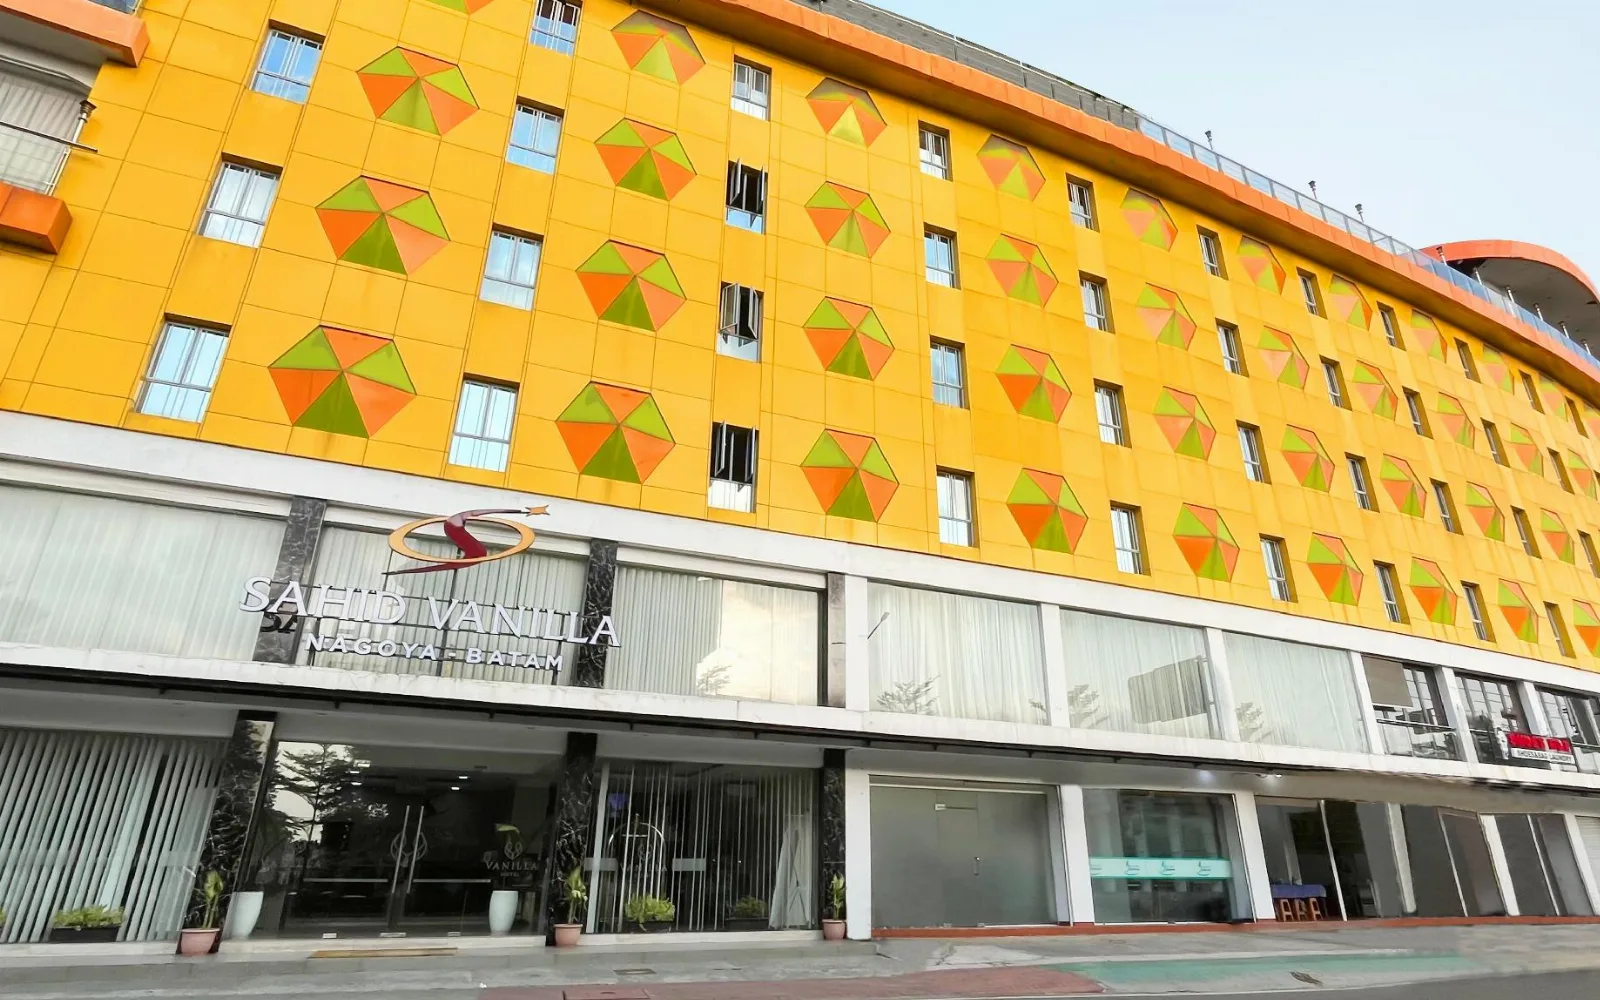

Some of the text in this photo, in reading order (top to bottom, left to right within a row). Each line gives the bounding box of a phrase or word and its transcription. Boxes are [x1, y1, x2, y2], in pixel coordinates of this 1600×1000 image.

[239, 576, 621, 648] SAHID VANILLA
[305, 632, 438, 661] NAGOYA
[466, 647, 563, 671] BATAM
[485, 860, 538, 871] VANILLA
